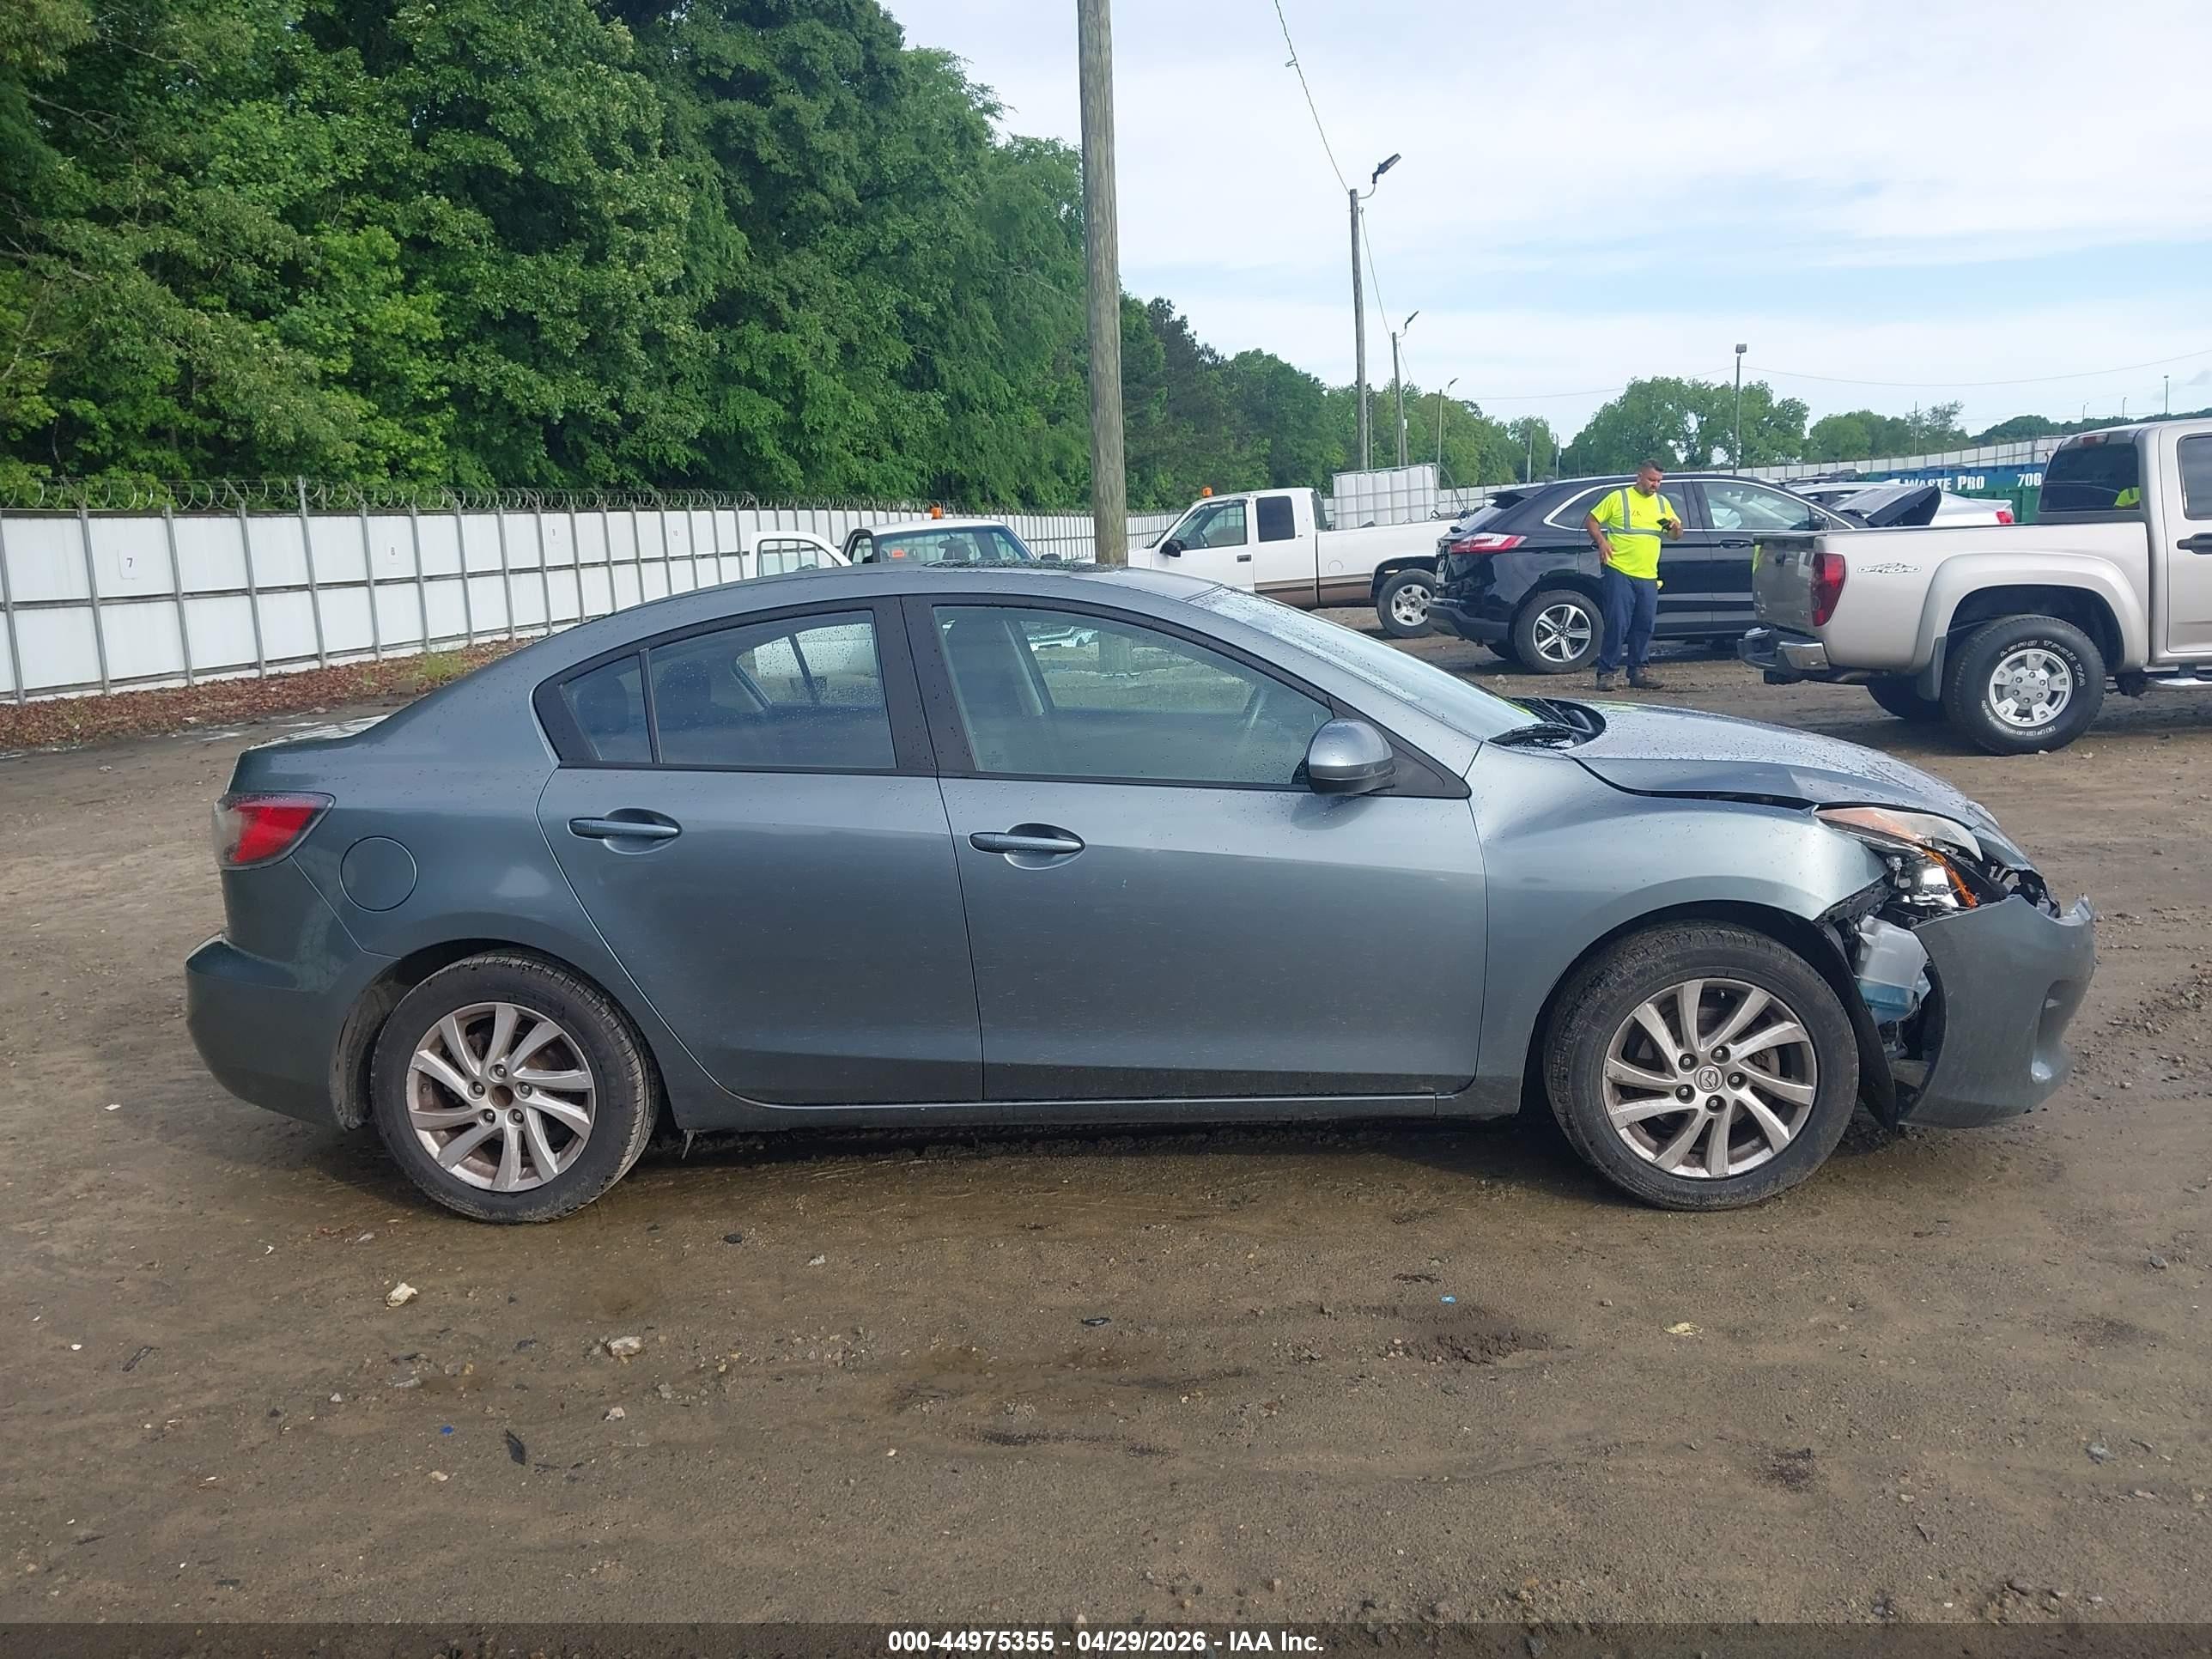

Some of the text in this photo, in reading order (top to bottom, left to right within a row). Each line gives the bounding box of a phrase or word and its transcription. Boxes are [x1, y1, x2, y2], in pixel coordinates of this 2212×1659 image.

[1904, 476, 1985, 492] WASTE PRO
[126, 557, 133, 568] 7
